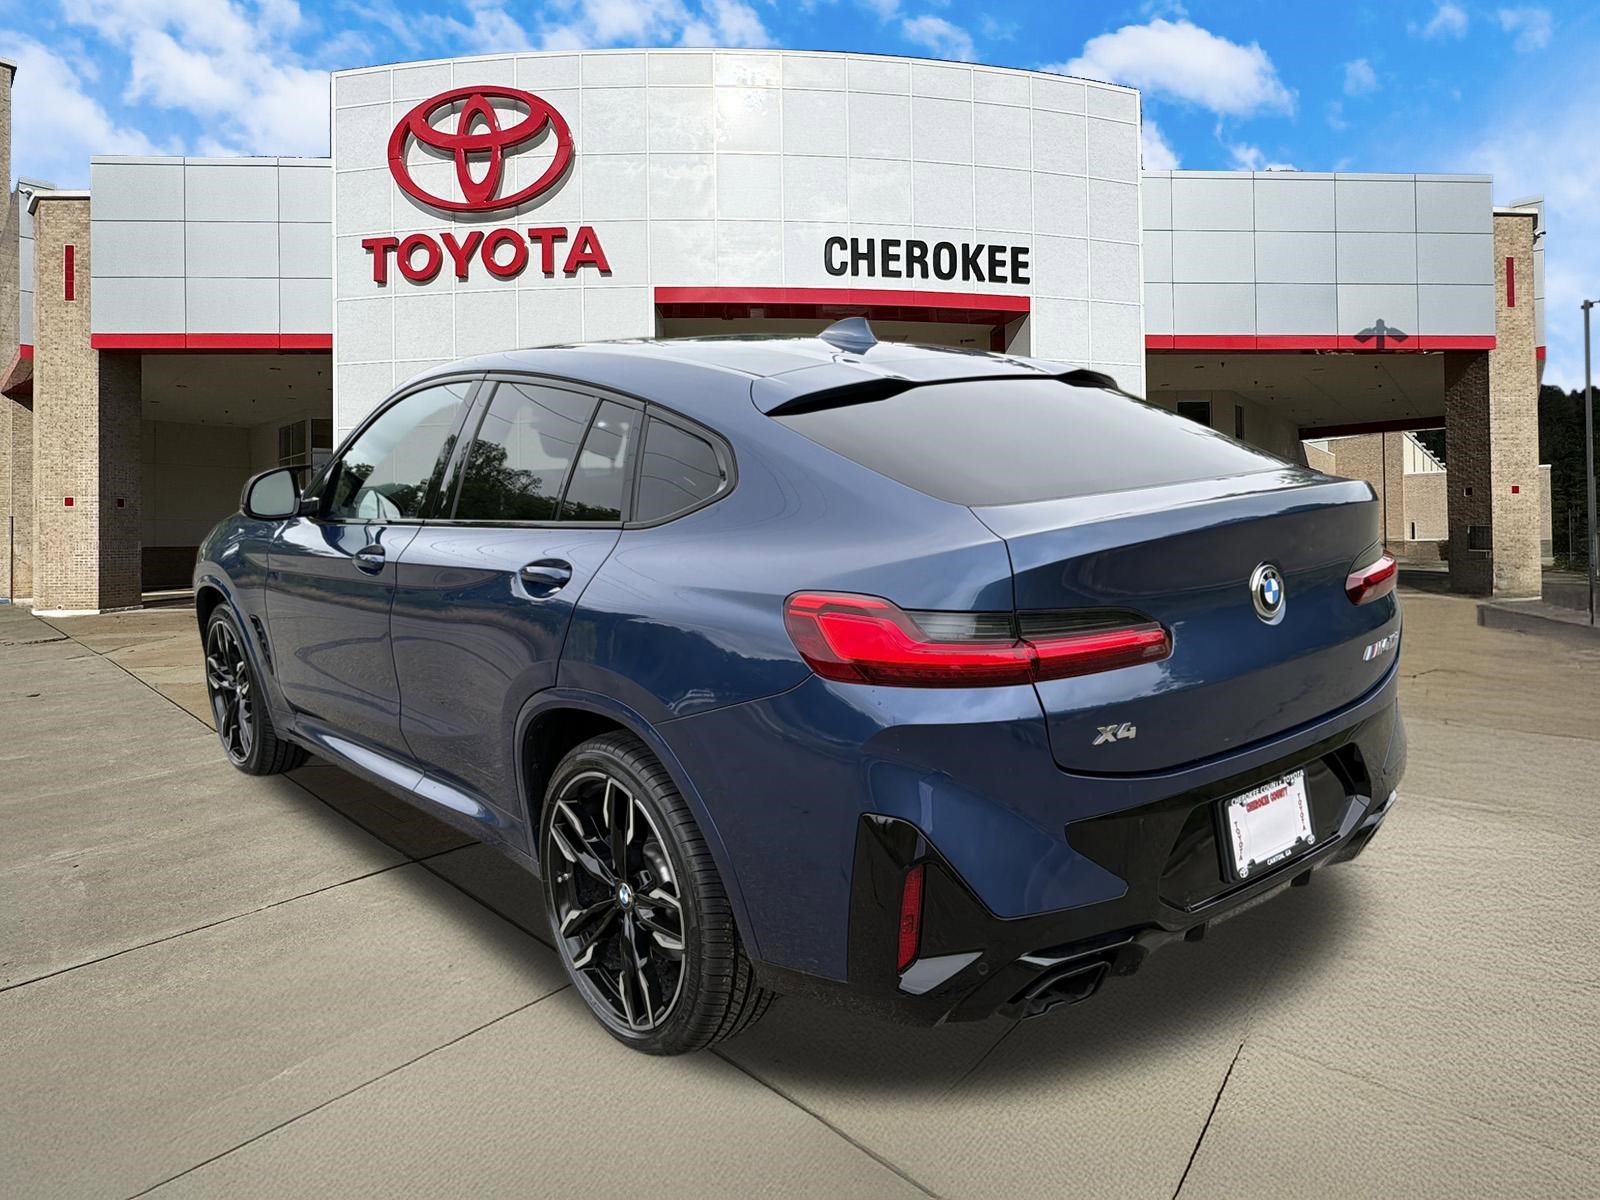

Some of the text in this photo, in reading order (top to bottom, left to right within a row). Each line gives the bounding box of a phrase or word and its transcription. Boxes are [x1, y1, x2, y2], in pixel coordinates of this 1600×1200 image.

[361, 226, 612, 287] TOYOTA
[824, 236, 1031, 285] CHEROKEE
[1092, 722, 1137, 746] X4
